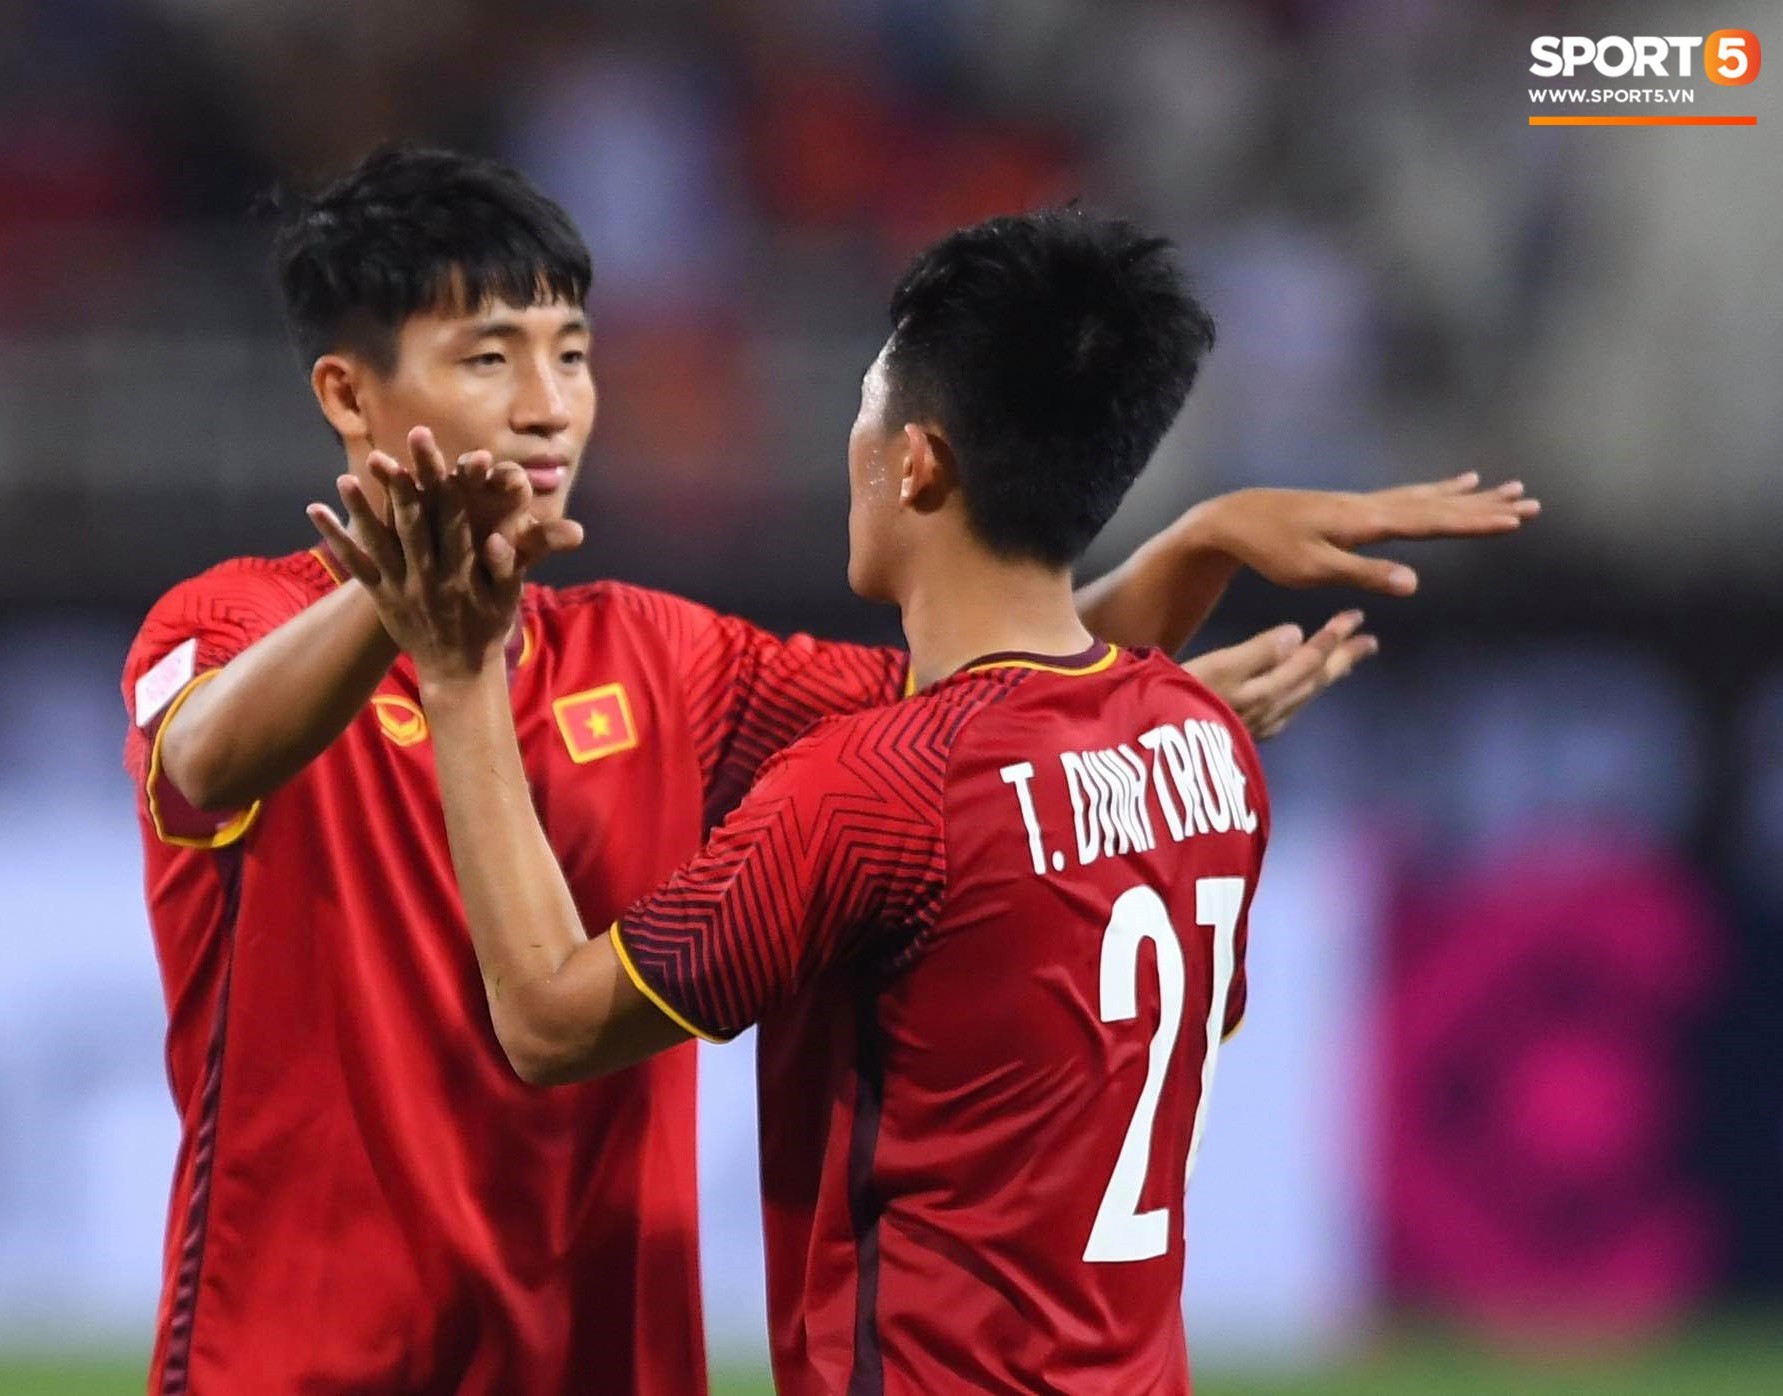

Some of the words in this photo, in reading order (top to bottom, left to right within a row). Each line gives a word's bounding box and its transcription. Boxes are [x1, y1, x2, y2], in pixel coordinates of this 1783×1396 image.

[1000, 761, 1065, 875] T.
[1060, 743, 1156, 865] DINH
[1082, 877, 1246, 1262] 21
